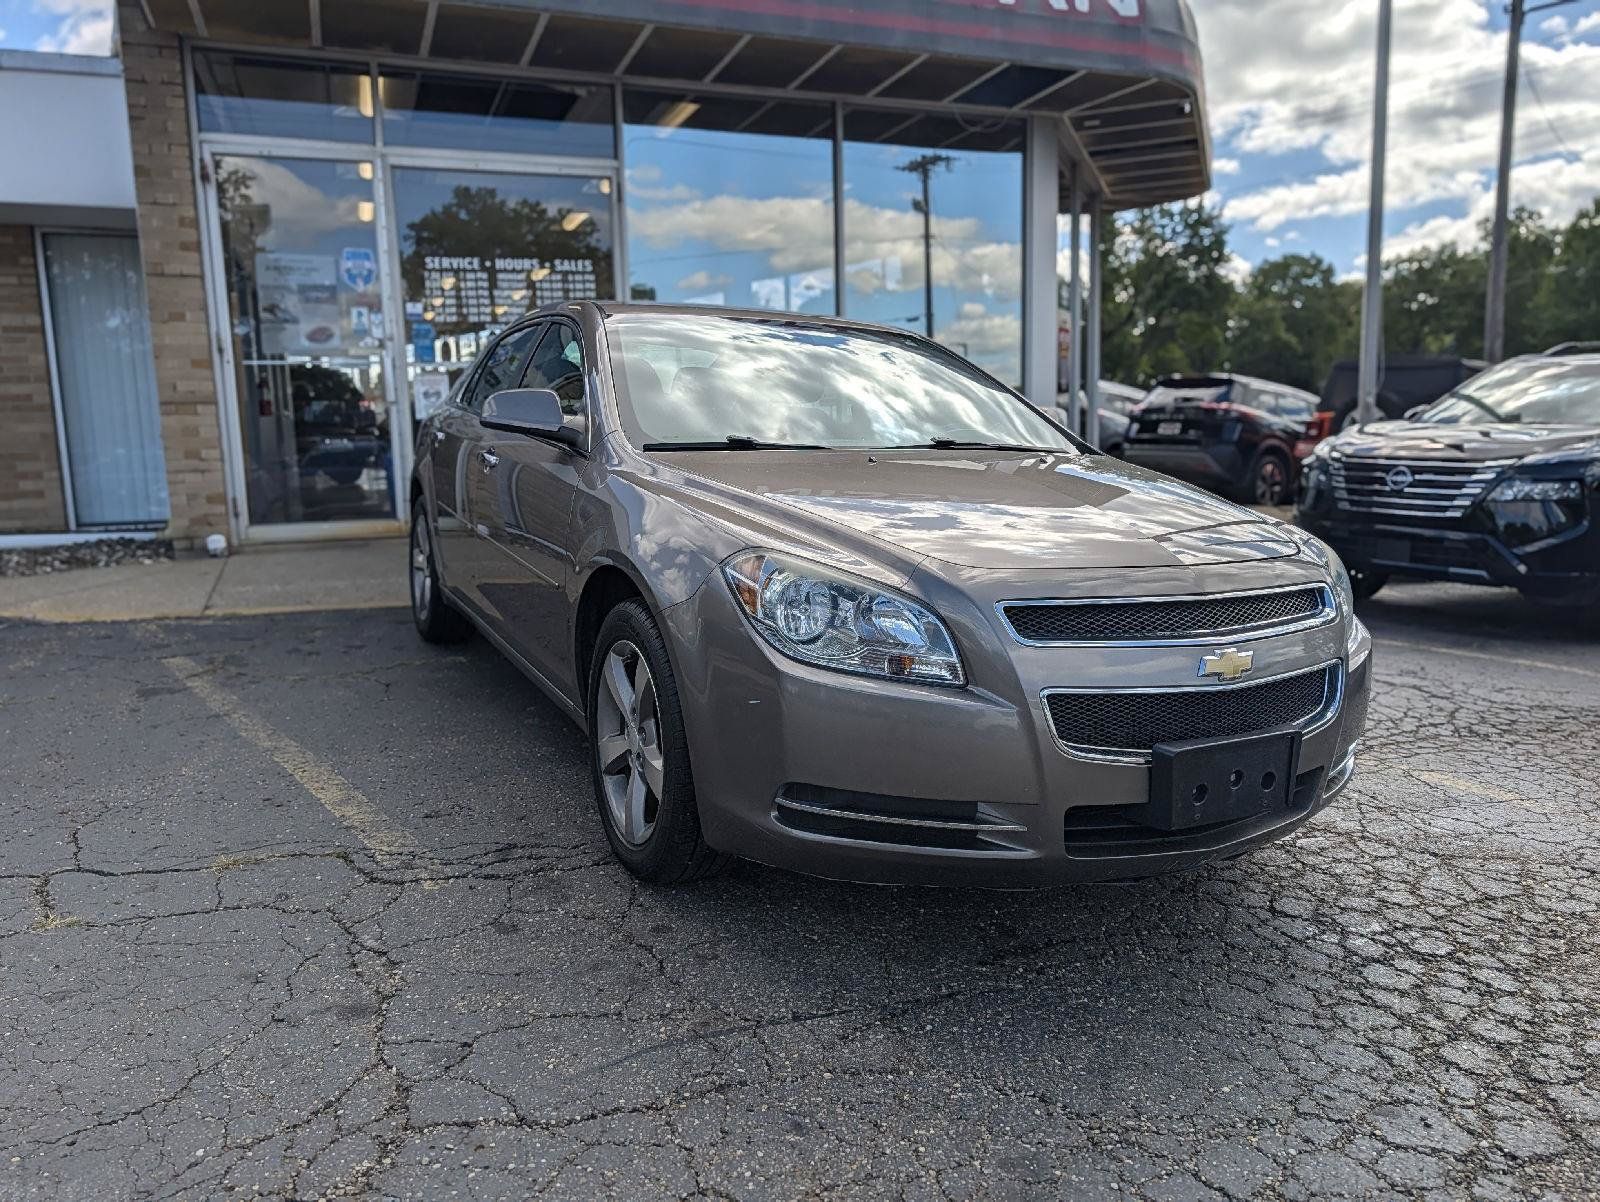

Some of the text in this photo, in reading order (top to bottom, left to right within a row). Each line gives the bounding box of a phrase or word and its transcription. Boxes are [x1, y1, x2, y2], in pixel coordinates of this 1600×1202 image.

[424, 256, 593, 272] SERVICE HOURS SALES
